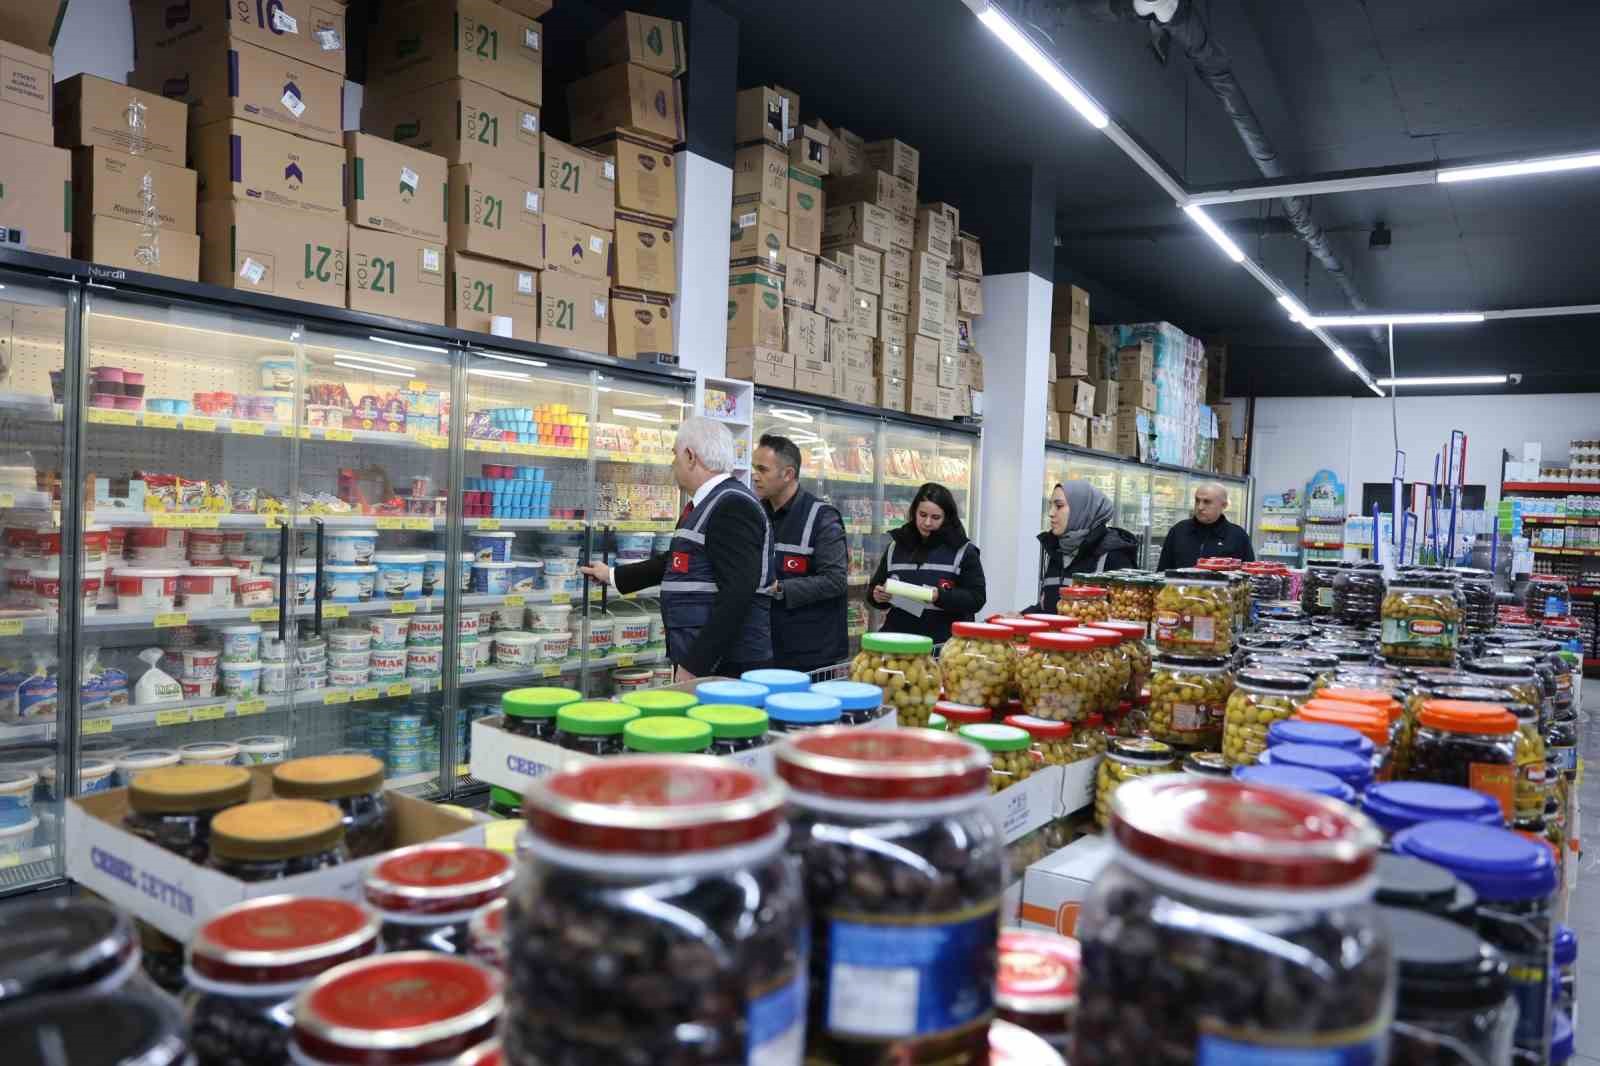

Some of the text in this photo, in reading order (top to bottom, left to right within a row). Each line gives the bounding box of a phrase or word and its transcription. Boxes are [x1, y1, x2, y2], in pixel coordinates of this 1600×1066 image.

[477, 24, 497, 60] 21
[478, 112, 498, 146] 21
[560, 161, 580, 194] 21
[483, 195, 503, 230] 21
[305, 243, 331, 283] 21
[371, 257, 395, 294] 21
[473, 281, 494, 314] 21
[556, 300, 575, 331] 21
